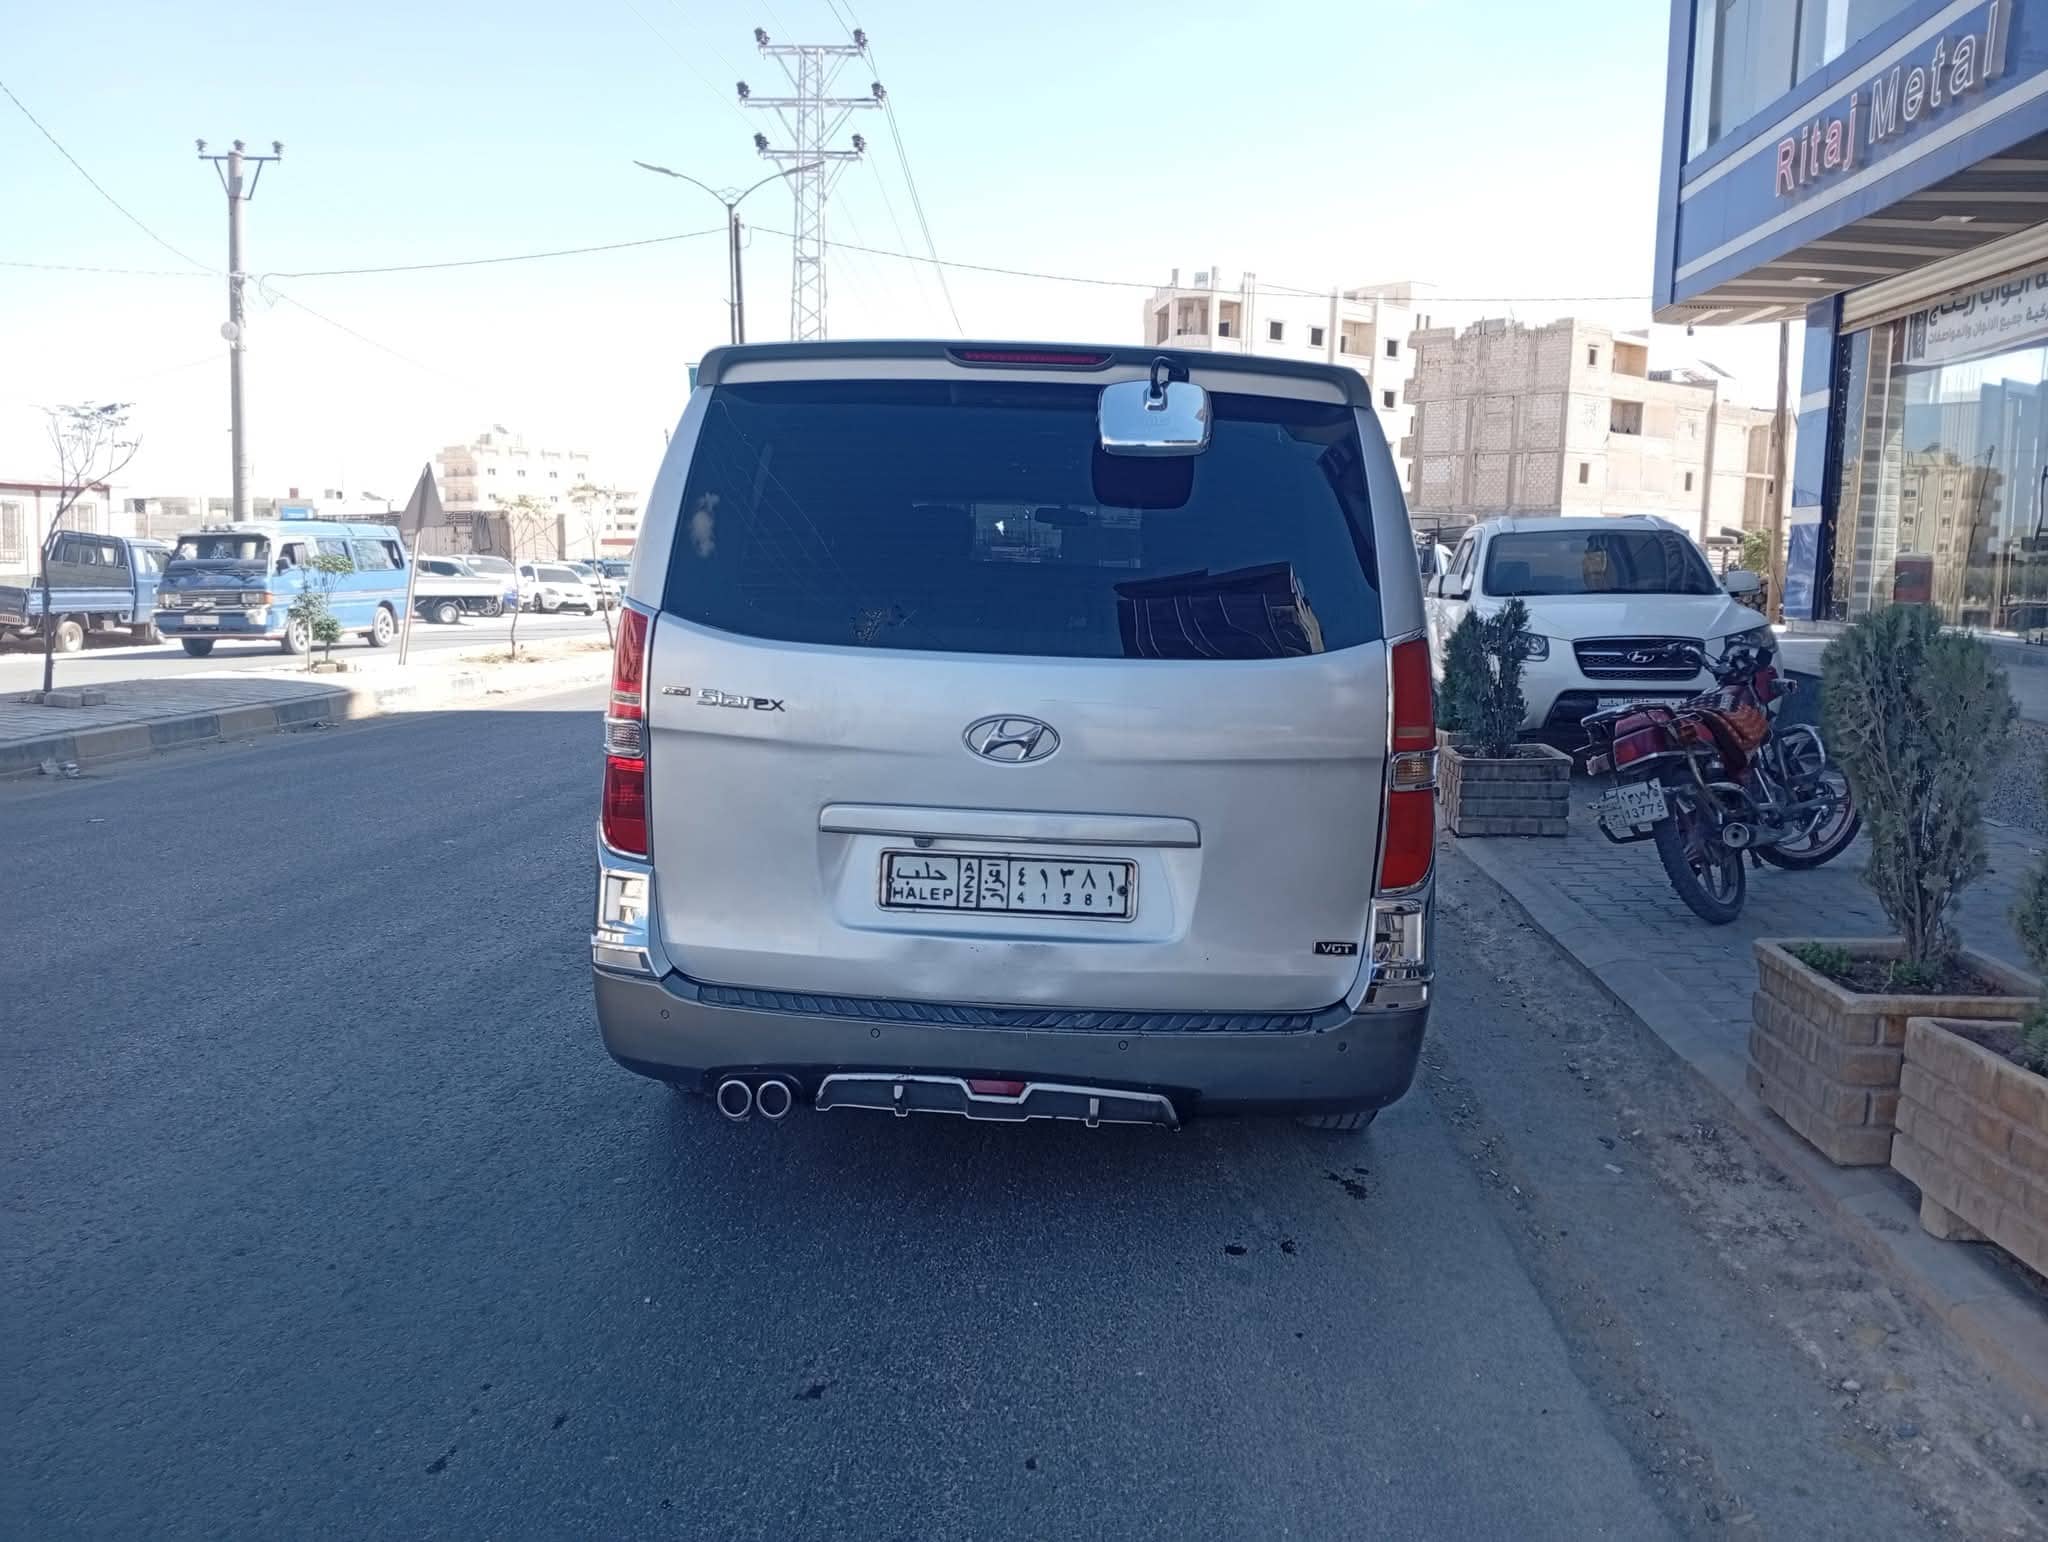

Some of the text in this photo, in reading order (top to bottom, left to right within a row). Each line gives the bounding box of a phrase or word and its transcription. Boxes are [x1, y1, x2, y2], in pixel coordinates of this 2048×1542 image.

[1775, 0, 2001, 197] Ritaj Metal
[896, 861, 948, 886] حلب
[1018, 867, 1115, 891] ٤١٣٨١
[892, 886, 954, 901] HALEP
[1017, 892, 1113, 907] 41381
[1321, 943, 1353, 954] VGT
